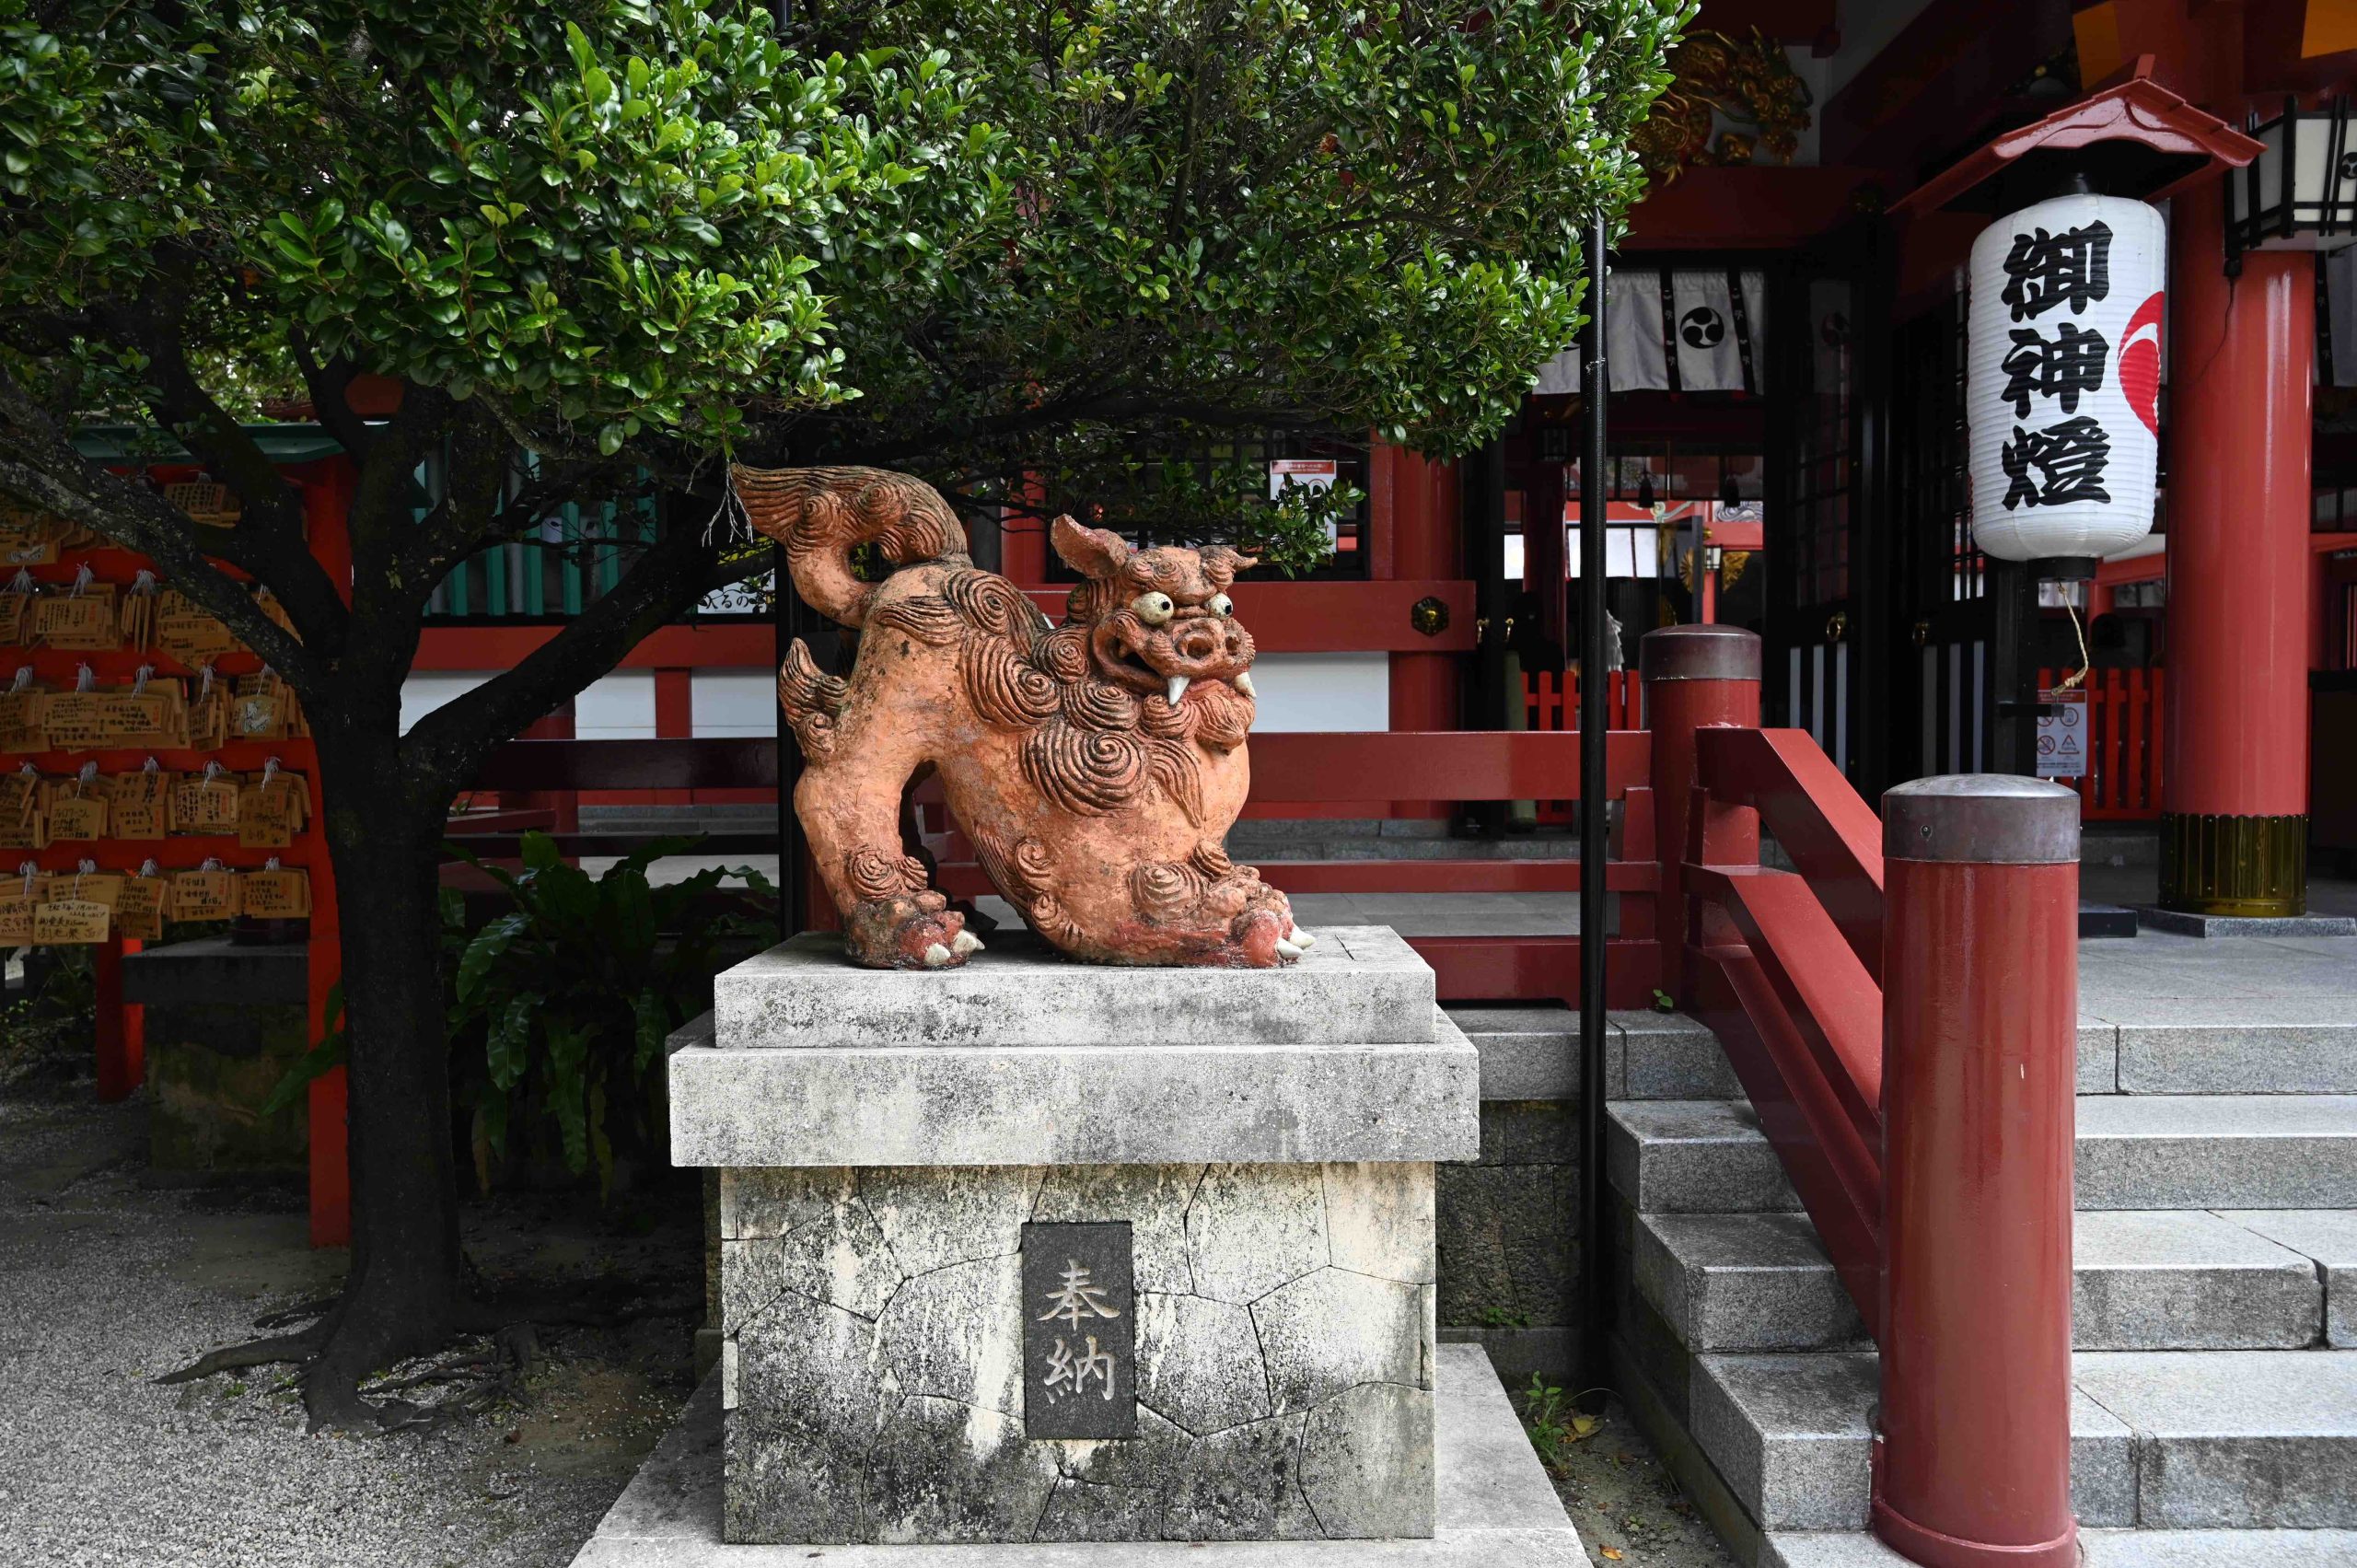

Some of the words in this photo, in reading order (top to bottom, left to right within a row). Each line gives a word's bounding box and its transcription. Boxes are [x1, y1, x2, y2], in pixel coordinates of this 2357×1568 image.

[2001, 219, 2113, 511] 御神燈
[1037, 1258, 1120, 1404] 奉納
